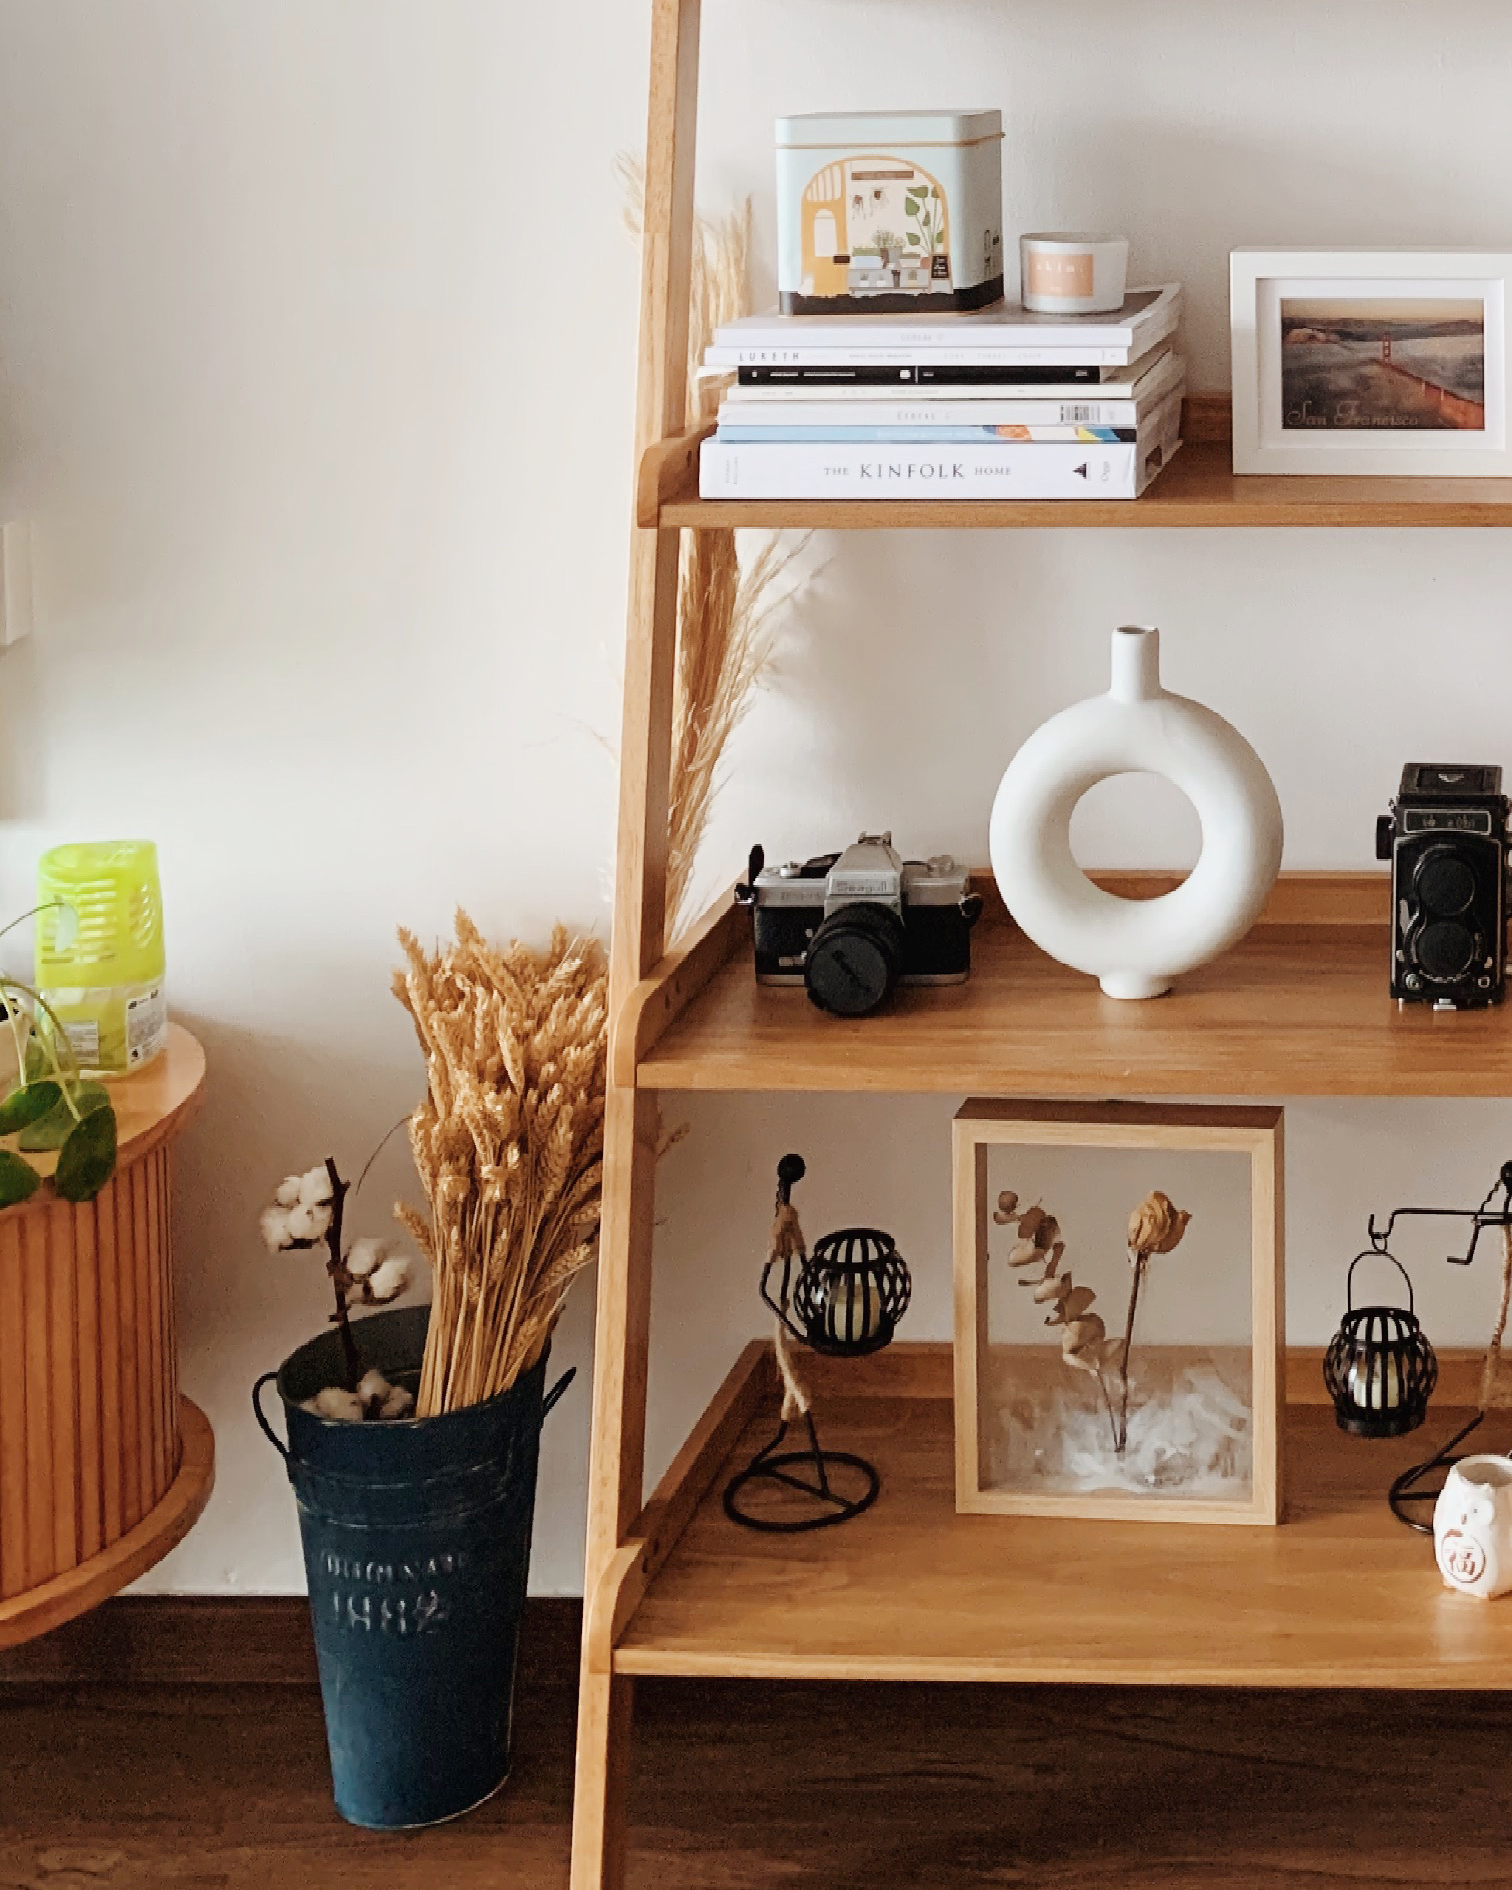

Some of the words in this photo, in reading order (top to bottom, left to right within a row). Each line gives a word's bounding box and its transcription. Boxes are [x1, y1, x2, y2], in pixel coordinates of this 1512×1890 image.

[1333, 400, 1417, 426] Francisco
[823, 466, 850, 476] THE
[859, 463, 966, 480] KINFOLK
[974, 466, 1012, 477] HOME
